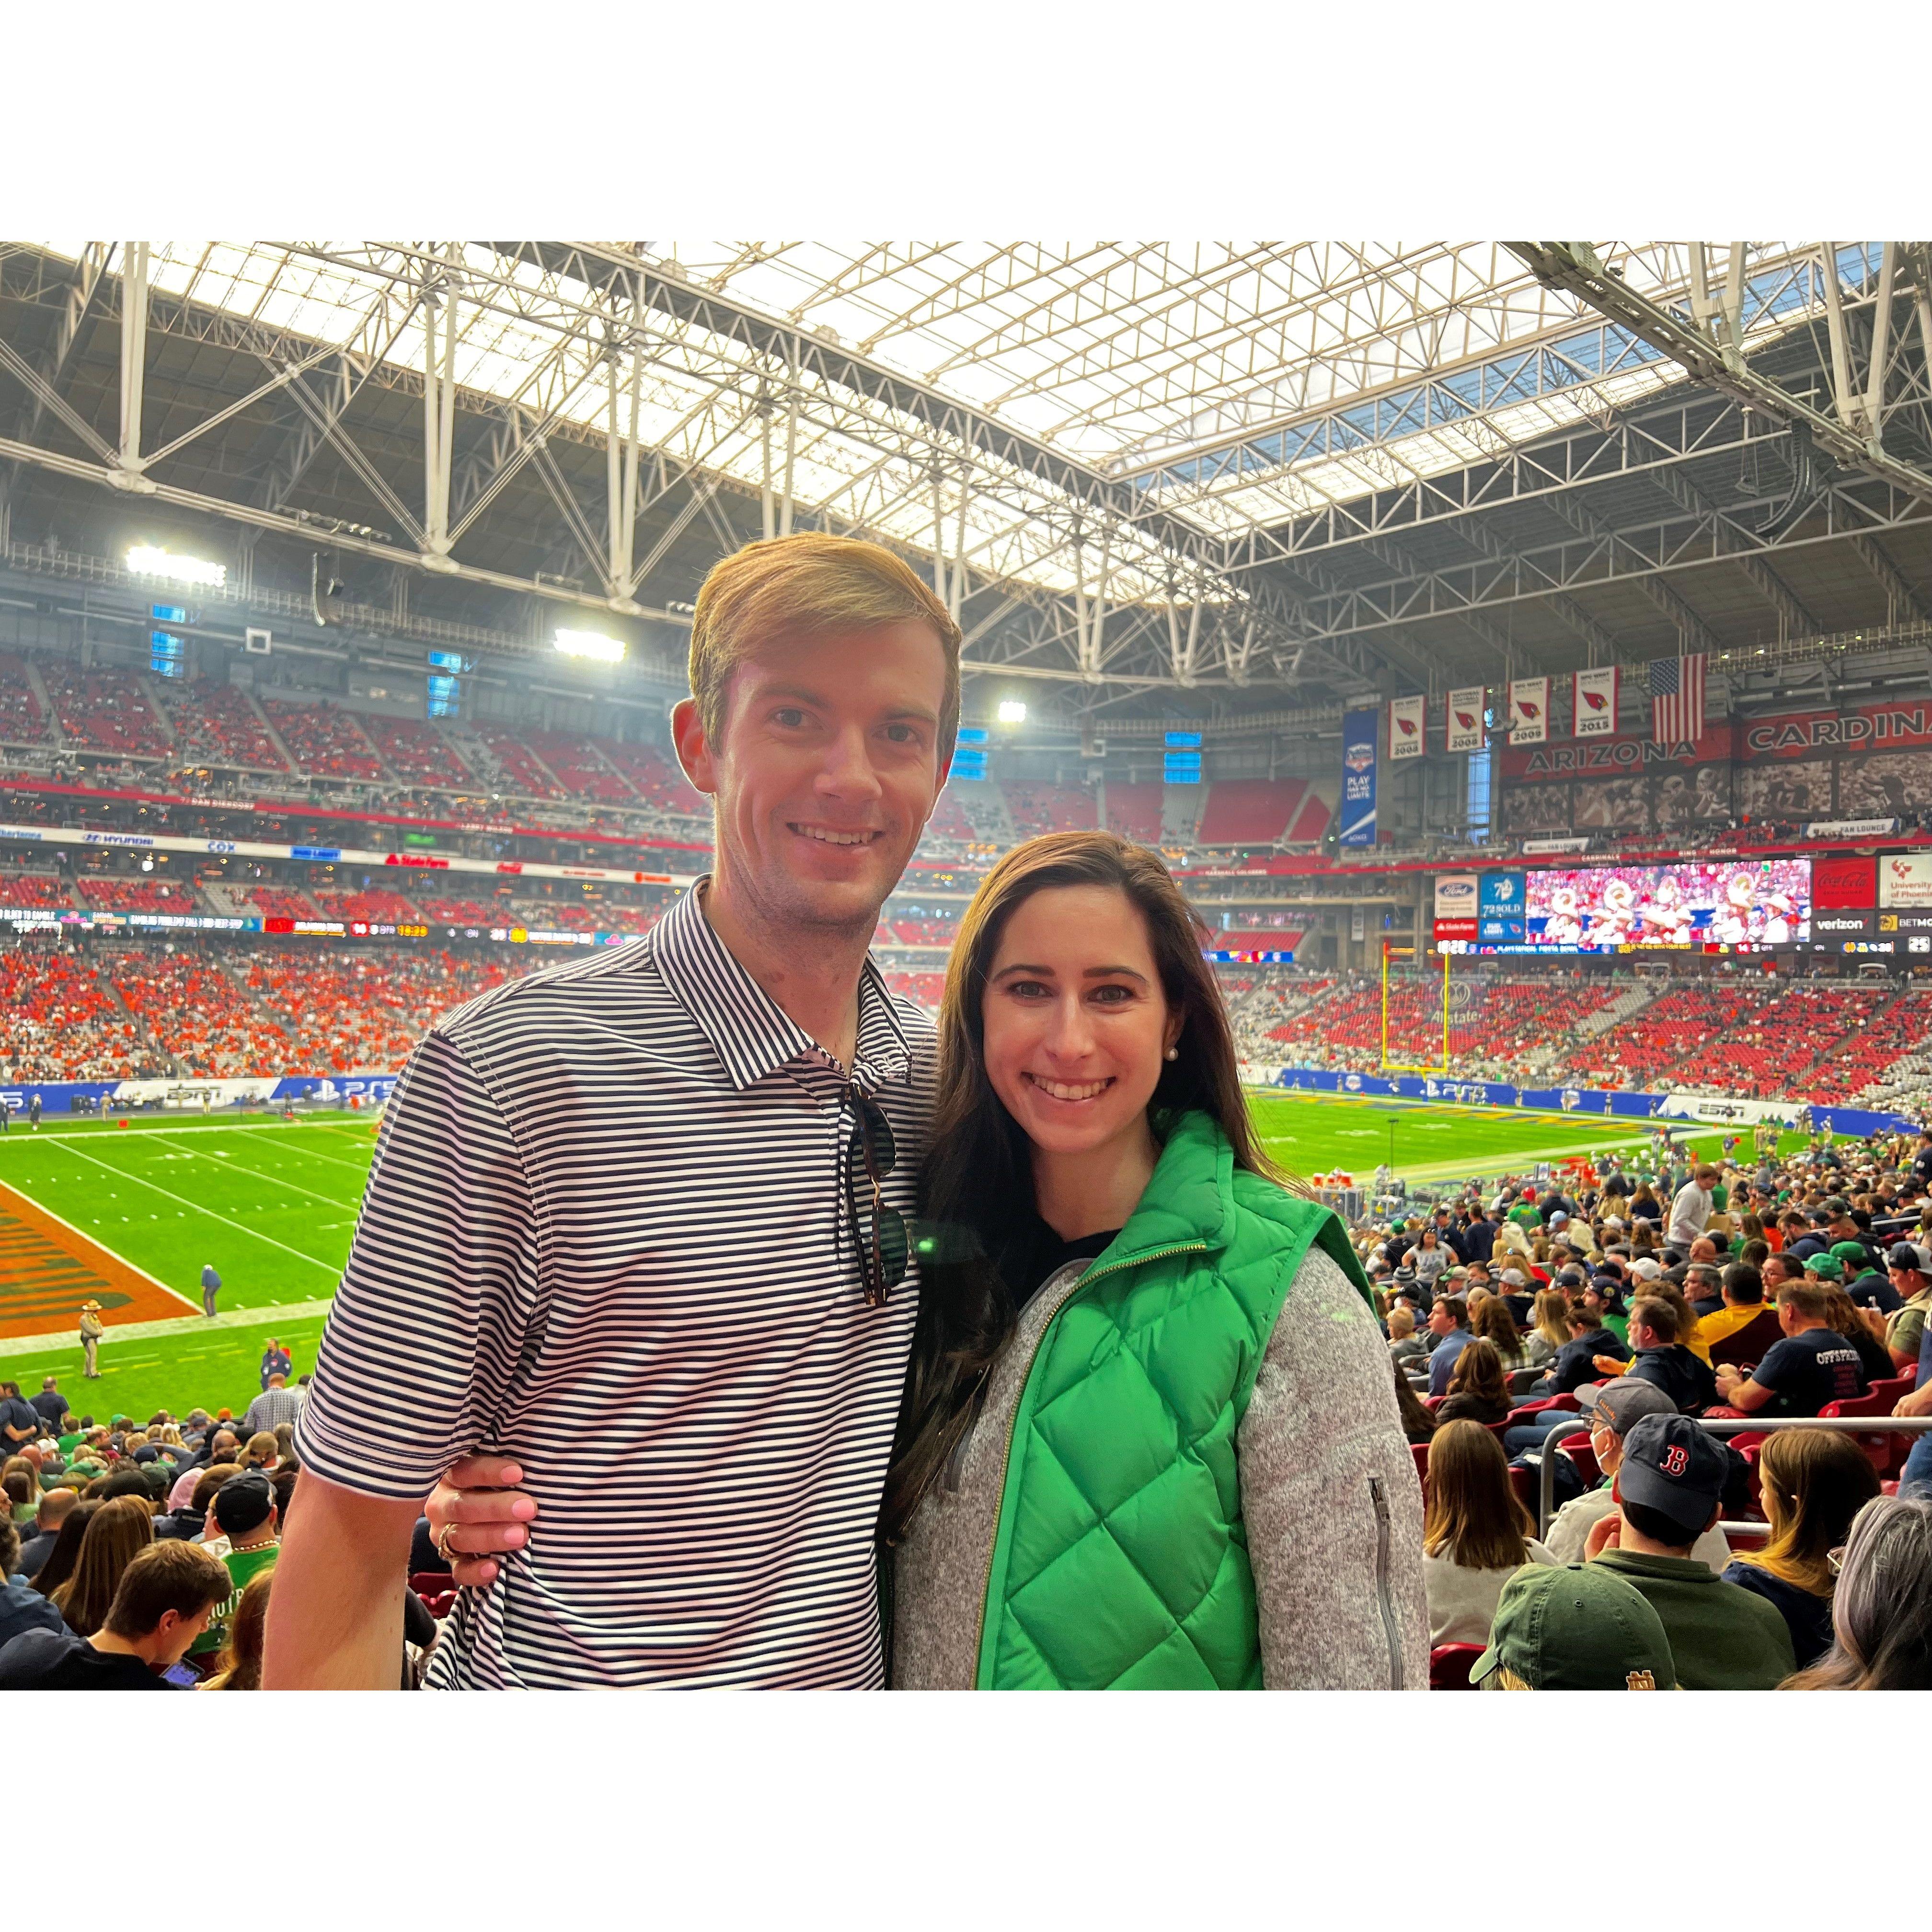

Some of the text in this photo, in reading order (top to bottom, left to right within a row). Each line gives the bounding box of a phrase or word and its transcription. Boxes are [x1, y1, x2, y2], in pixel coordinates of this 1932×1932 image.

[1580, 721, 1609, 732] 2015
[1748, 709, 1932, 751] CARDIN
[1525, 739, 1697, 774] ARIZONA
[1347, 776, 1371, 786] PLAY
[1840, 826, 1855, 834] FAN
[1856, 824, 1886, 833] LOUNGE
[104, 835, 154, 846] HYUNDAI
[208, 841, 235, 853] COX
[1444, 884, 1468, 896] Ford
[1891, 882, 1932, 890] University
[1891, 890, 1899, 898] of
[1817, 918, 1863, 930] verizon
[1910, 937, 1929, 951] 25
[1431, 1010, 1479, 1025] Alstate
[1659, 1444, 1690, 1477] B
